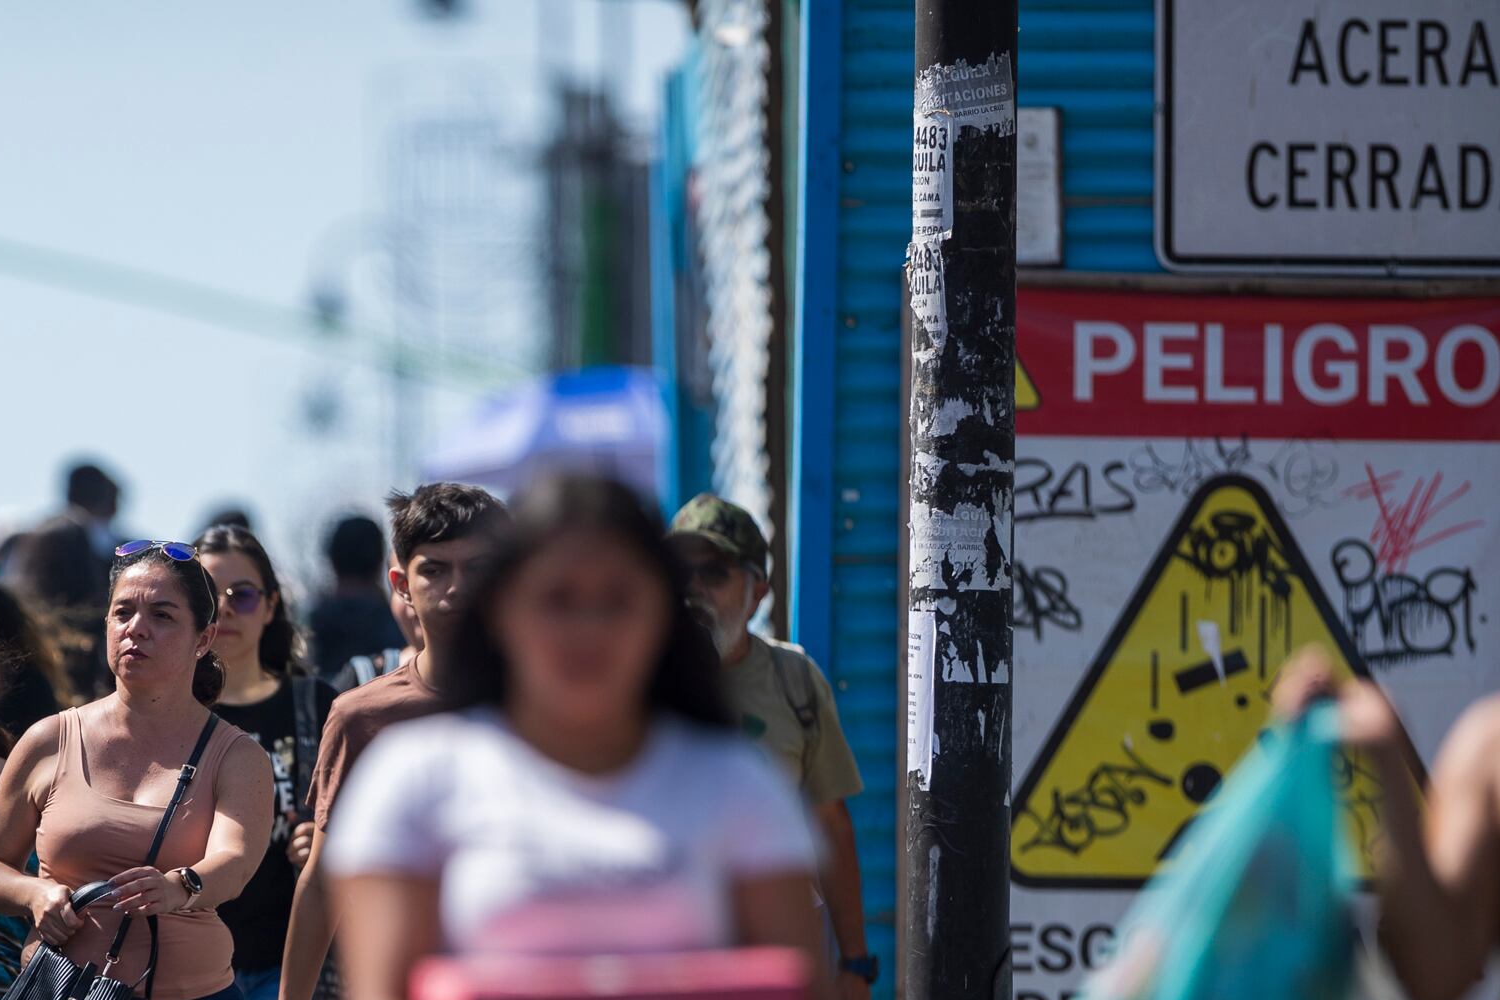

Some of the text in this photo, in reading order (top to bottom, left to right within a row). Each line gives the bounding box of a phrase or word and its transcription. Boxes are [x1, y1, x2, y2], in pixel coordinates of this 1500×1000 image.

[1288, 18, 1499, 86] ACERA
[954, 109, 979, 118] BARRIO
[1246, 141, 1500, 211] CERRAD
[1073, 321, 1500, 406] PELIGRO
